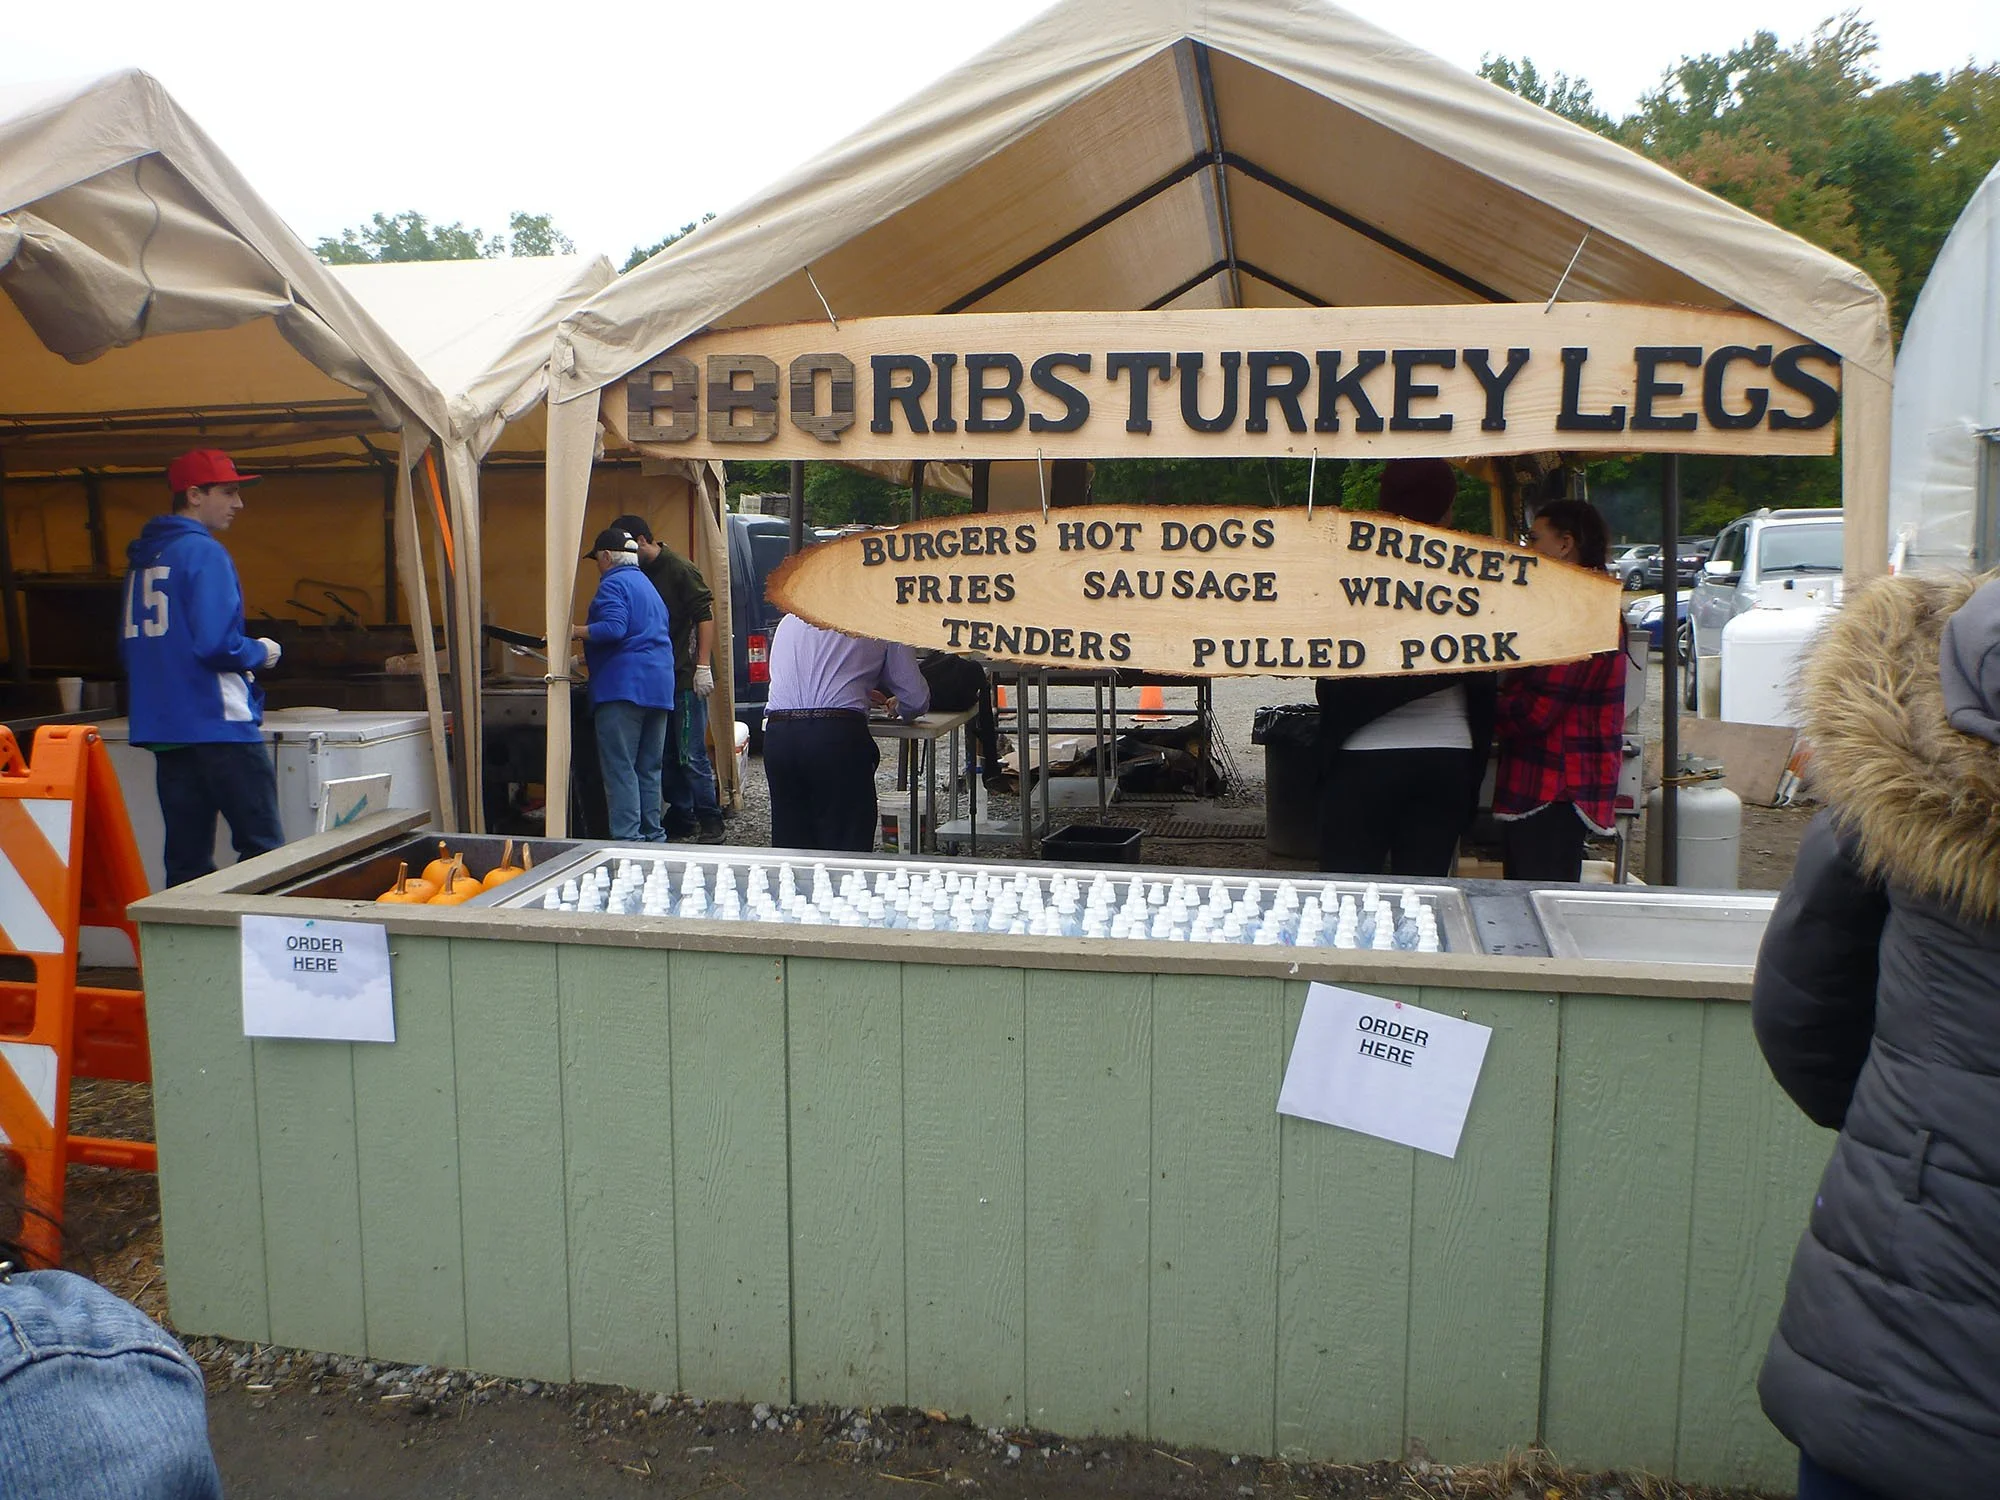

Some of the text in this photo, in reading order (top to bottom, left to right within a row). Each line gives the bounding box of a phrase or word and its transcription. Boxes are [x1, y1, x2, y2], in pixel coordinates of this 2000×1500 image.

[626, 344, 1842, 443] BBQ RIBS TURKEY LEGS
[861, 519, 1538, 586] BURGERS HOT DOGS BRISKET
[124, 565, 171, 639] 15
[895, 569, 1481, 617] FRIES SAUSAGE WINGS
[942, 617, 1521, 670] TENDERS PULLED PORK
[286, 935, 343, 952] ORDER
[293, 956, 338, 971] HERE
[1358, 1015, 1429, 1047] ORDER
[1359, 1038, 1415, 1066] HERE
